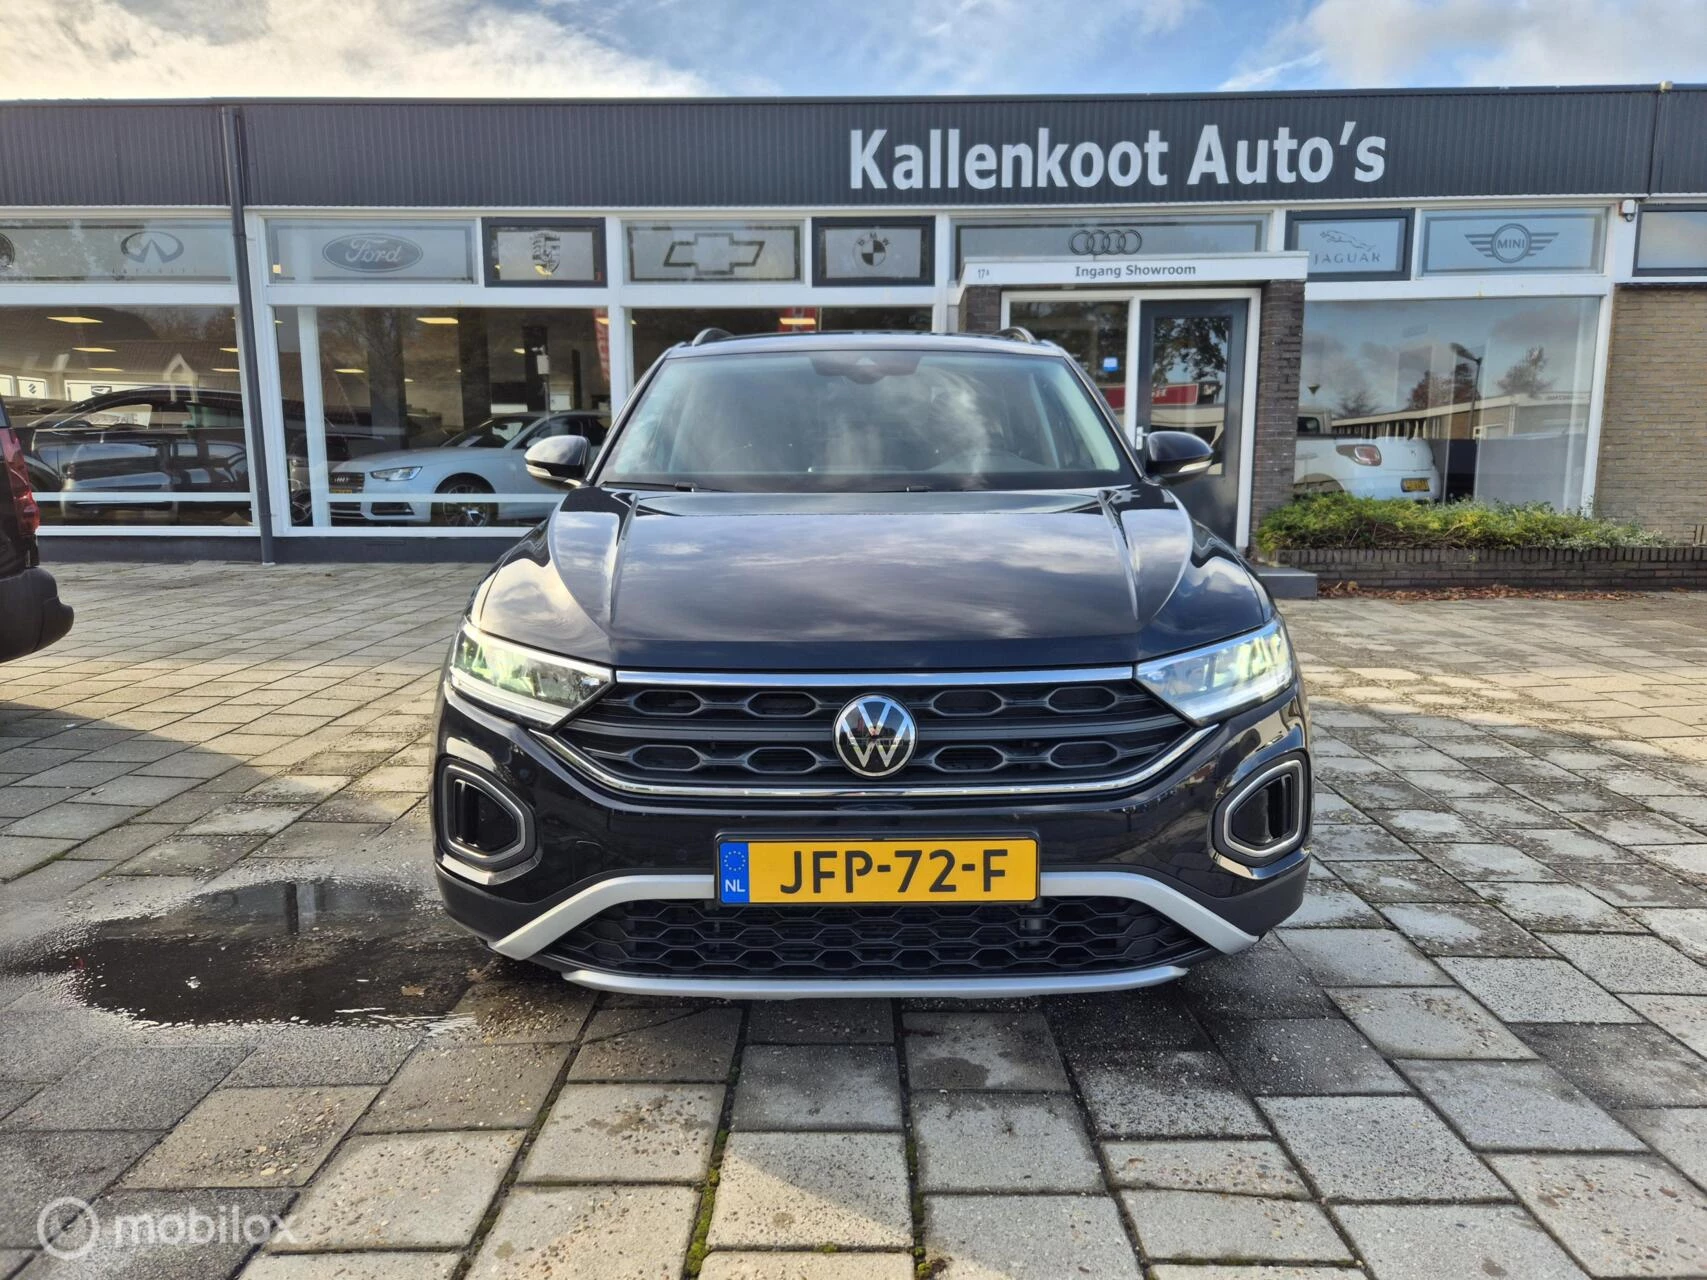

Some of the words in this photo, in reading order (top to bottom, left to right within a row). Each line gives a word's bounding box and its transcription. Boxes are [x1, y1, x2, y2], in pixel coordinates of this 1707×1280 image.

[849, 127, 1169, 190] Kallenkoot
[1186, 121, 1387, 185] Auto's
[344, 238, 402, 263] Ford
[1497, 237, 1526, 250] MINI
[1313, 251, 1381, 265] JAGUAR
[1075, 265, 1122, 279] Ingang
[1125, 263, 1197, 276] Showroom
[780, 848, 1008, 894] JFP-72-F
[725, 879, 746, 893] NL
